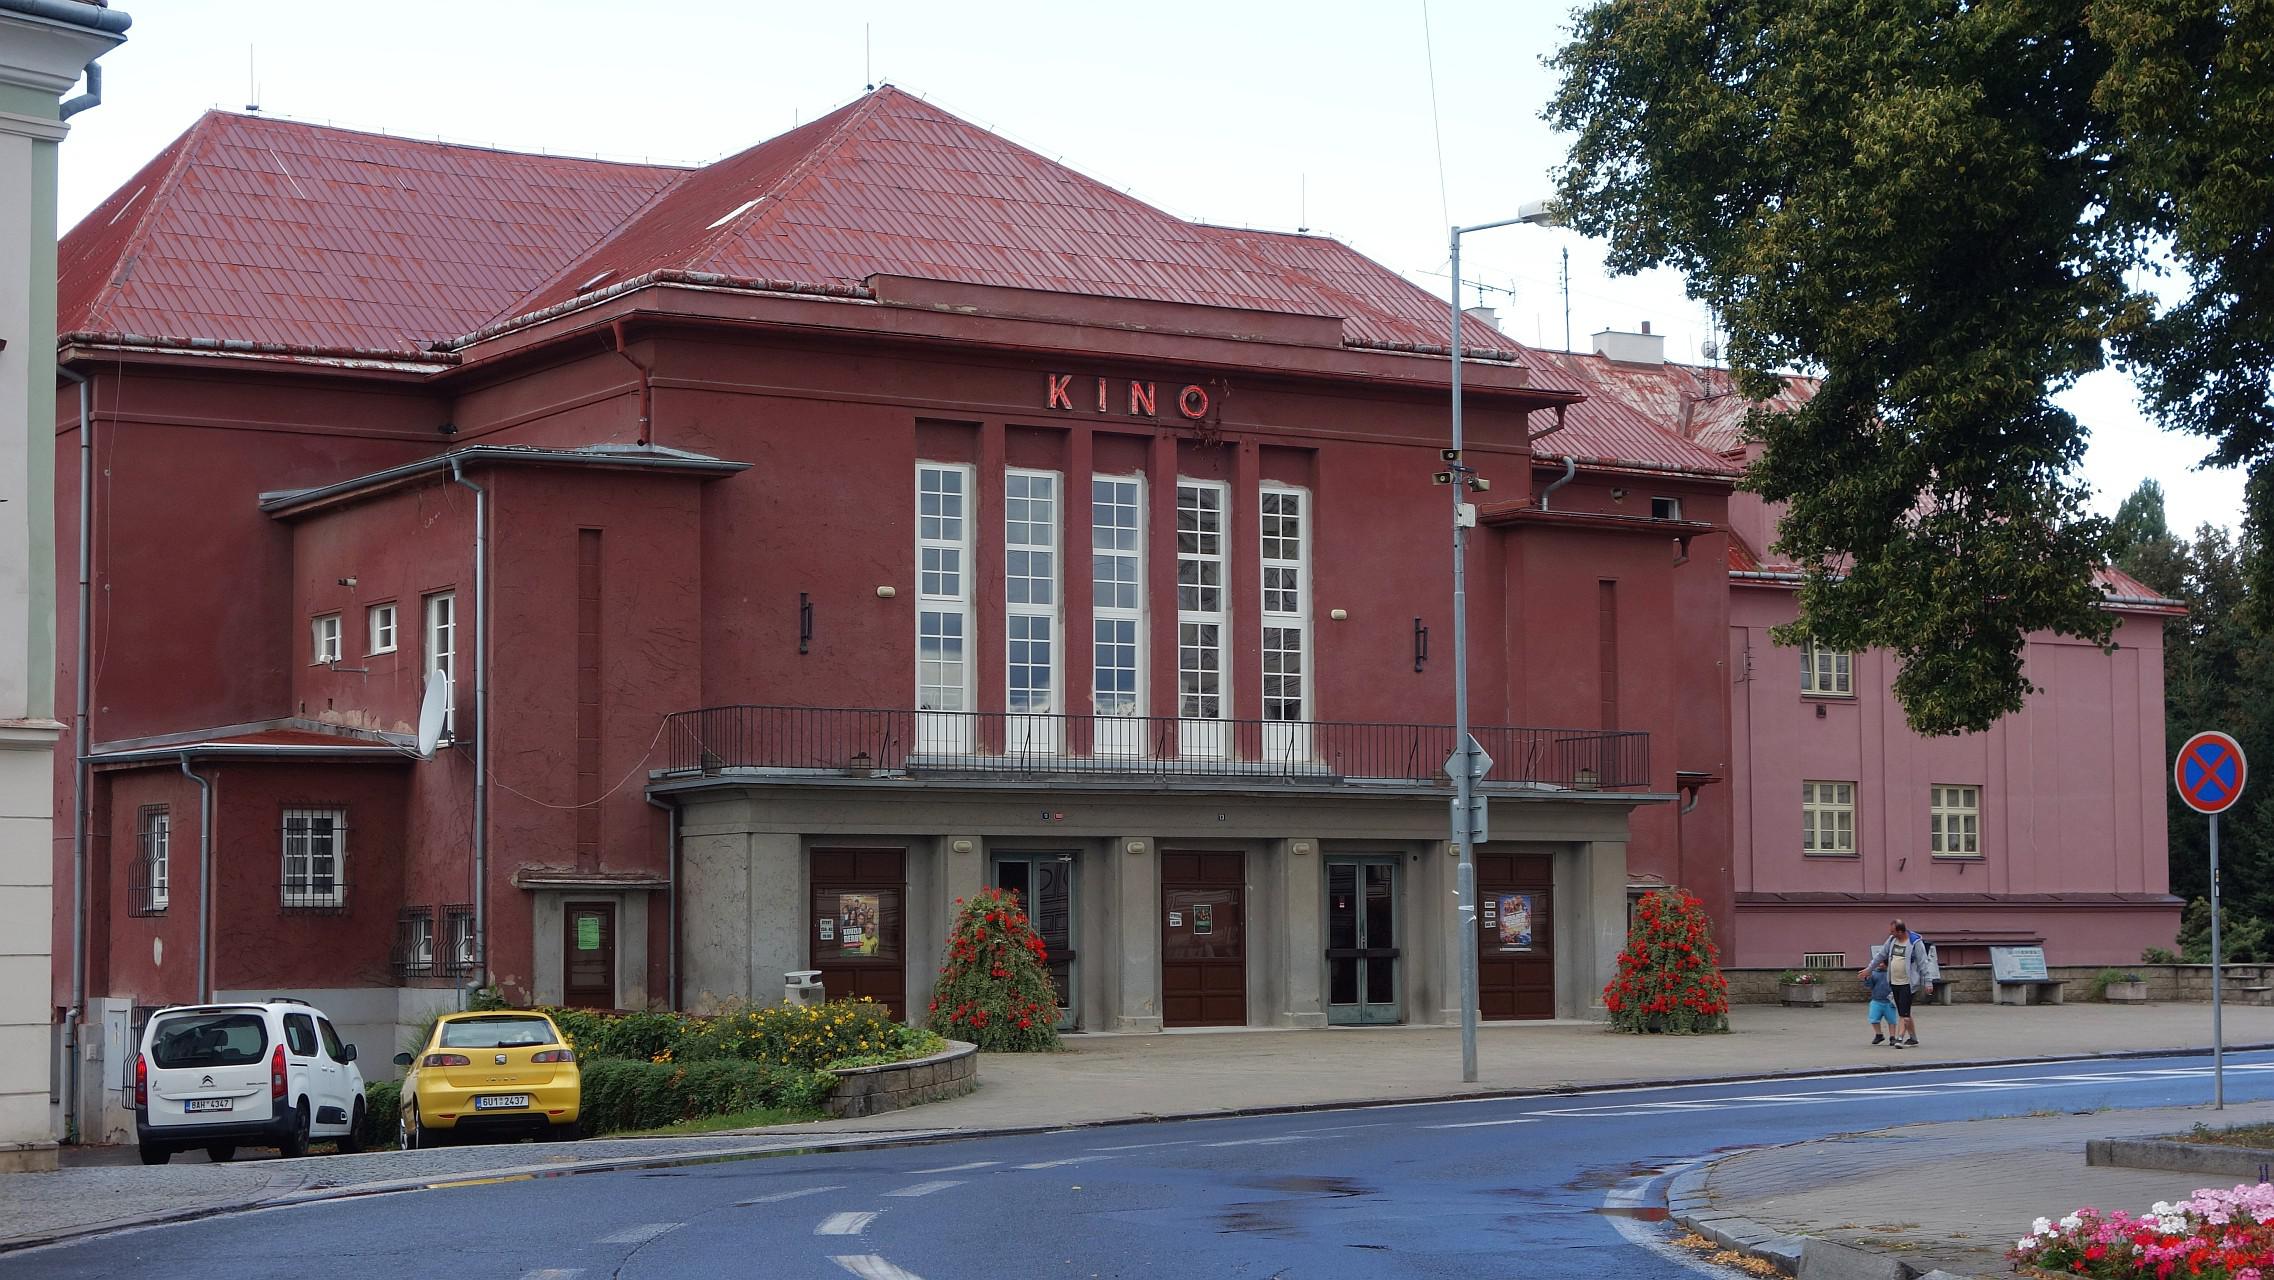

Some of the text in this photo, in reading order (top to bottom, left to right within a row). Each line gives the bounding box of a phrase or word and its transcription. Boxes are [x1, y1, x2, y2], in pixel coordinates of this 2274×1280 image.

[1047, 374, 1209, 419] KINO
[210, 1099, 229, 1108] 4347
[483, 1096, 524, 1106] 6U1 2437
